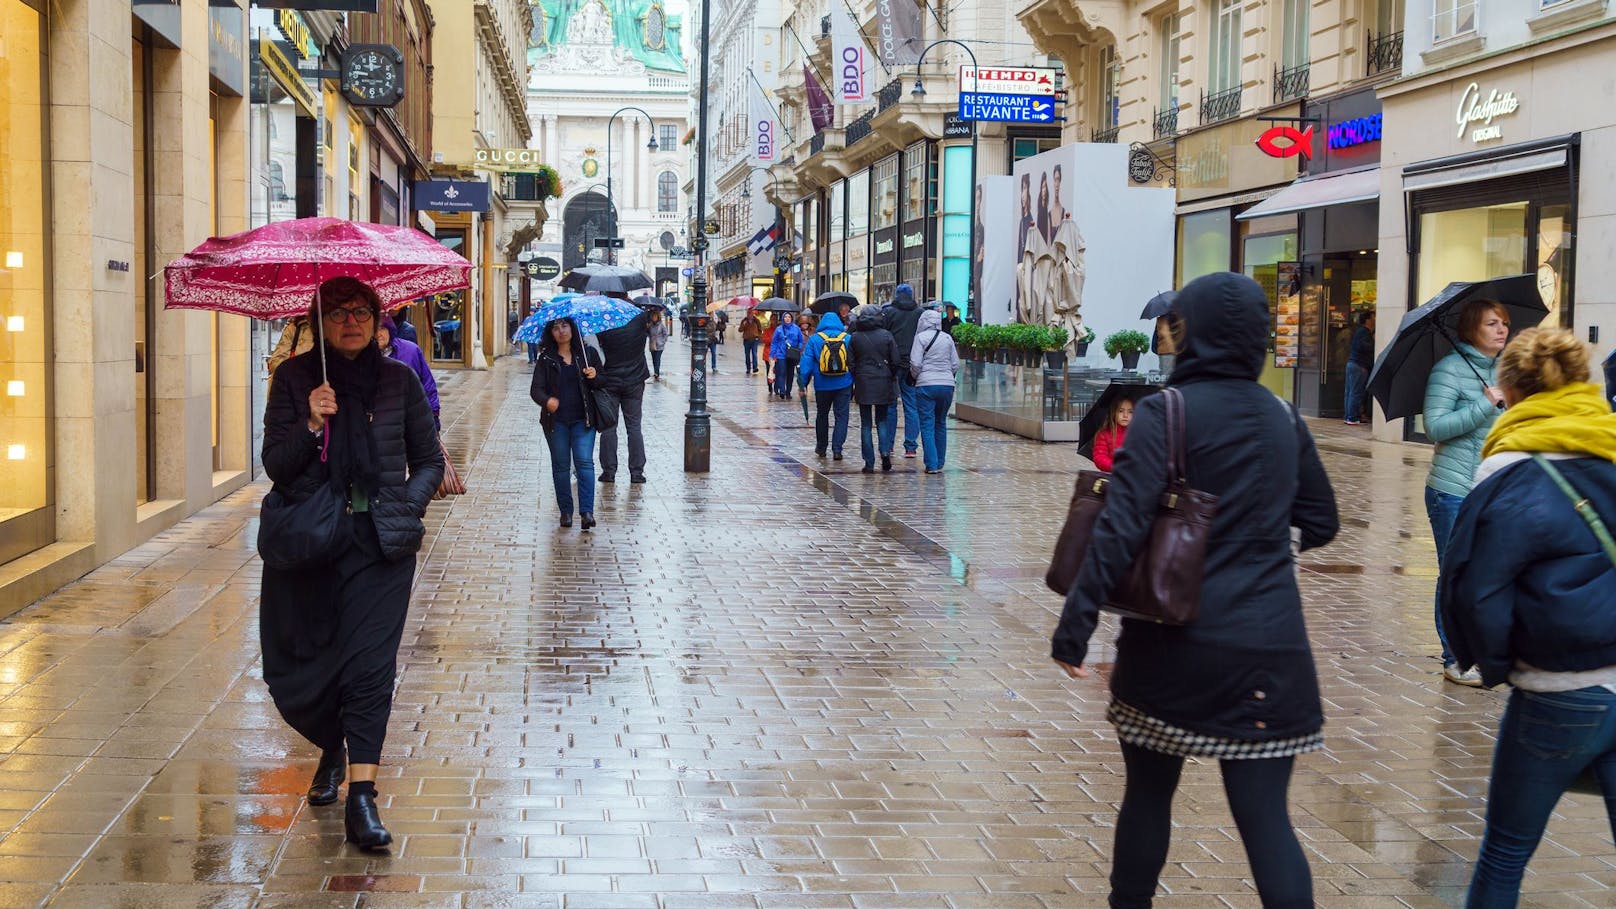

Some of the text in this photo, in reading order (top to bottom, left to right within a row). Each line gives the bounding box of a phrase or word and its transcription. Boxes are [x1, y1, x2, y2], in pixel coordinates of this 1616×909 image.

[882, 23, 895, 59] DOLCE
[843, 47, 859, 94] BDO
[979, 70, 1035, 81] TEMPO
[964, 94, 1031, 107] RESTAURANT
[963, 105, 1031, 120] LEVANTE
[758, 120, 771, 156] BDO
[1472, 126, 1503, 143] ORIGINAL
[476, 150, 538, 162] GUCCI
